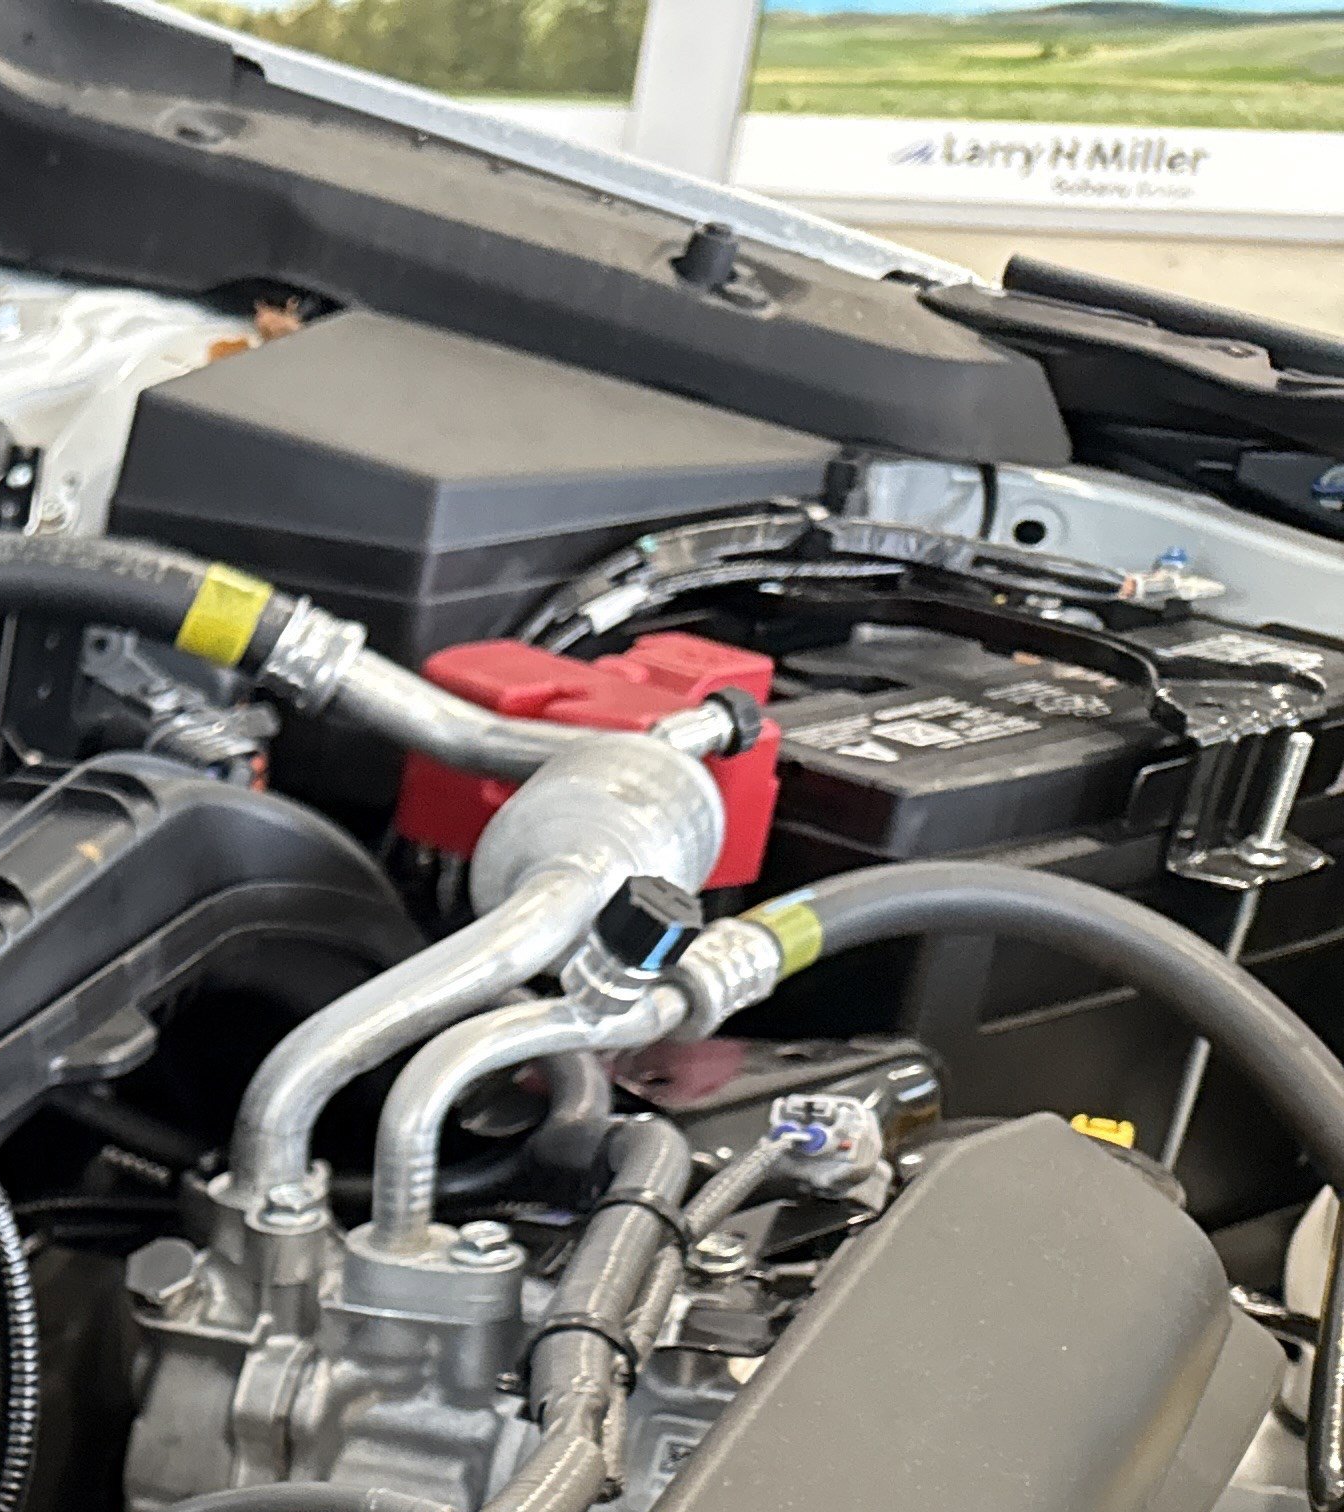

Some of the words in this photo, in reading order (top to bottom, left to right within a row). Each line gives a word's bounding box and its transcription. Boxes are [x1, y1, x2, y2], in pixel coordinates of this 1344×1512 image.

[942, 132, 1042, 177] Larry
[1049, 135, 1081, 170] H
[1086, 136, 1209, 175] Miller
